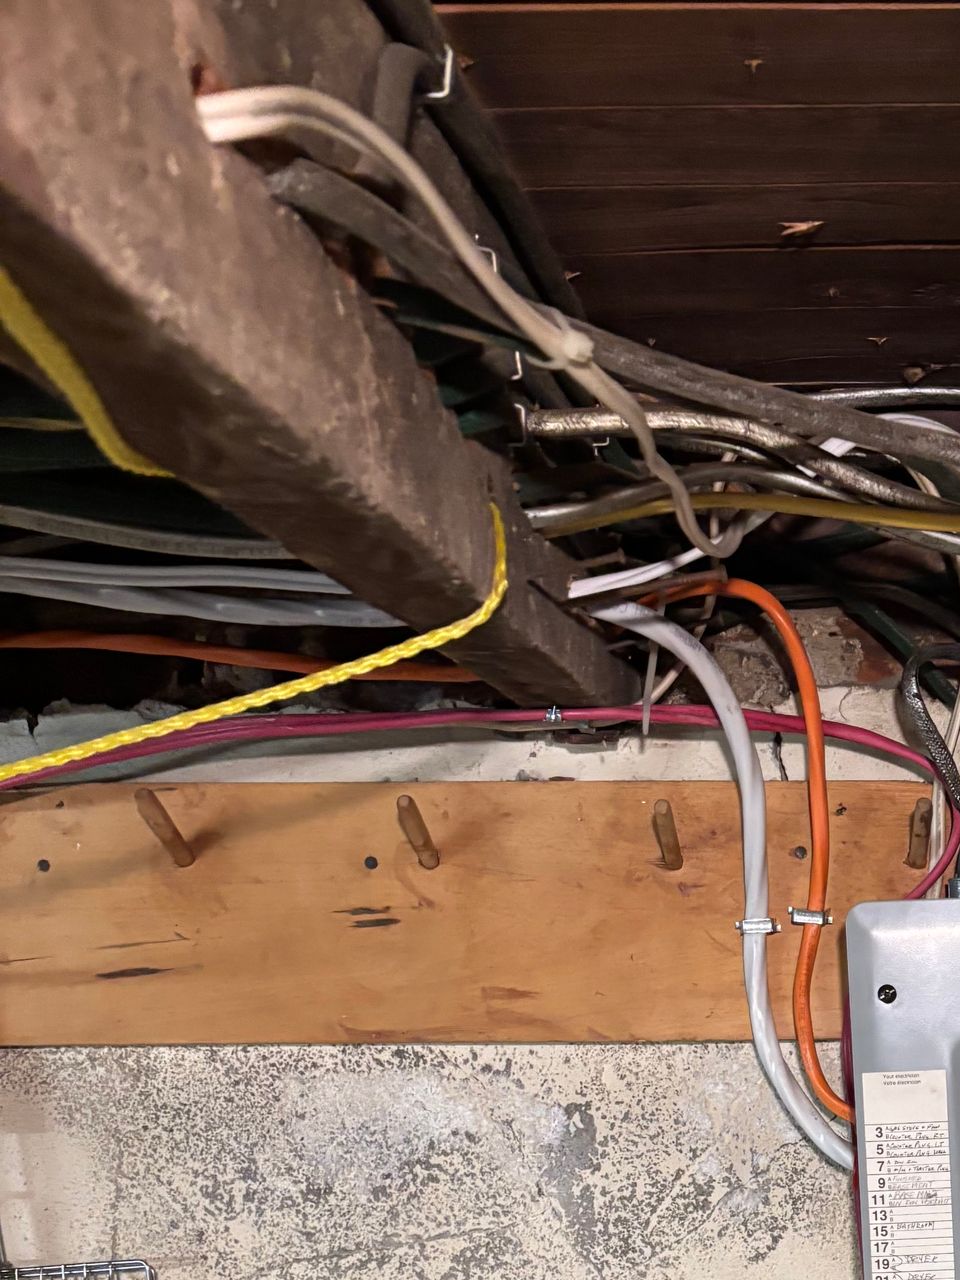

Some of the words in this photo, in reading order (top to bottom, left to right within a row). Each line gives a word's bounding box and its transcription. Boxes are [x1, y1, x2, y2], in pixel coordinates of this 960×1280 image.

[875, 1127, 883, 1138] 3
[876, 1144, 884, 1155] 5
[877, 1161, 884, 1172] 7
[878, 1177, 886, 1189] 9
[872, 1195, 885, 1205] 11
[872, 1210, 887, 1221] 13
[873, 1226, 888, 1237] 15
[874, 1242, 888, 1253] 17
[875, 1259, 890, 1270] 19
